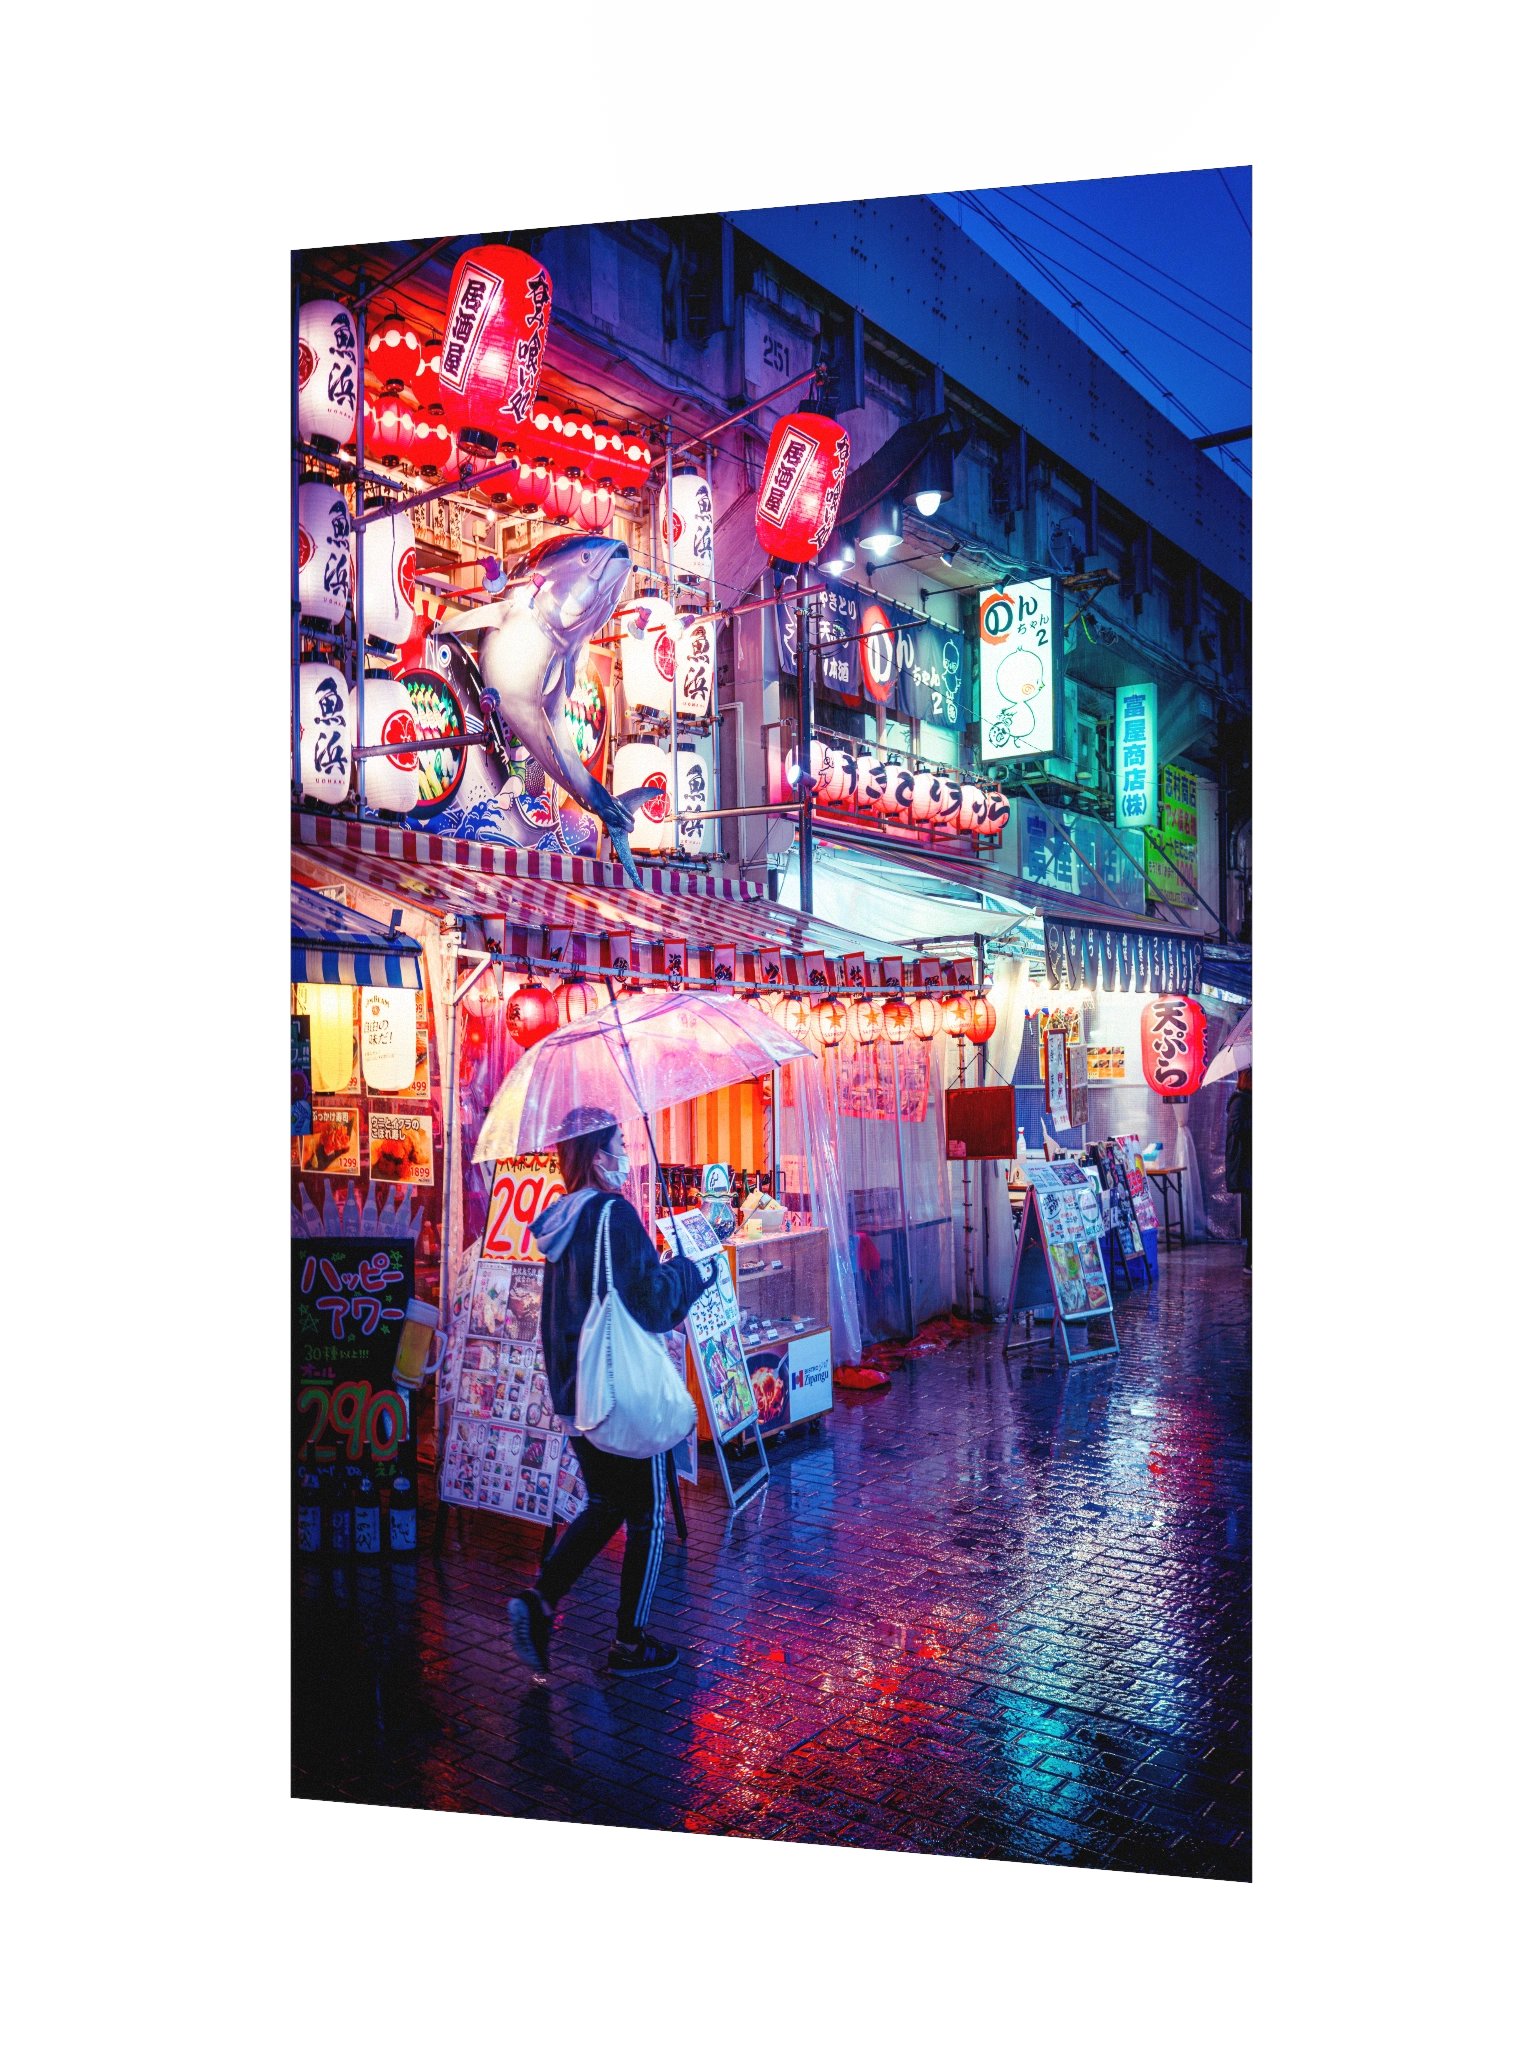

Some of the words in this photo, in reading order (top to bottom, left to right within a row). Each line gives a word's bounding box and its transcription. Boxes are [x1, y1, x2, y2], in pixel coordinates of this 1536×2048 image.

[443, 278, 487, 378] 居酒屋
[763, 335, 790, 377] 251
[765, 440, 806, 515] 居酒屋
[313, 676, 348, 776] 魚浜
[1151, 1000, 1188, 1088] 天ぷら
[339, 1157, 357, 1168] 1299
[410, 1167, 430, 1178] 1899
[300, 1252, 405, 1294] ハッピー
[315, 1296, 405, 1340] アワー
[804, 1370, 829, 1387] Zipangu
[297, 1380, 408, 1462] 290
